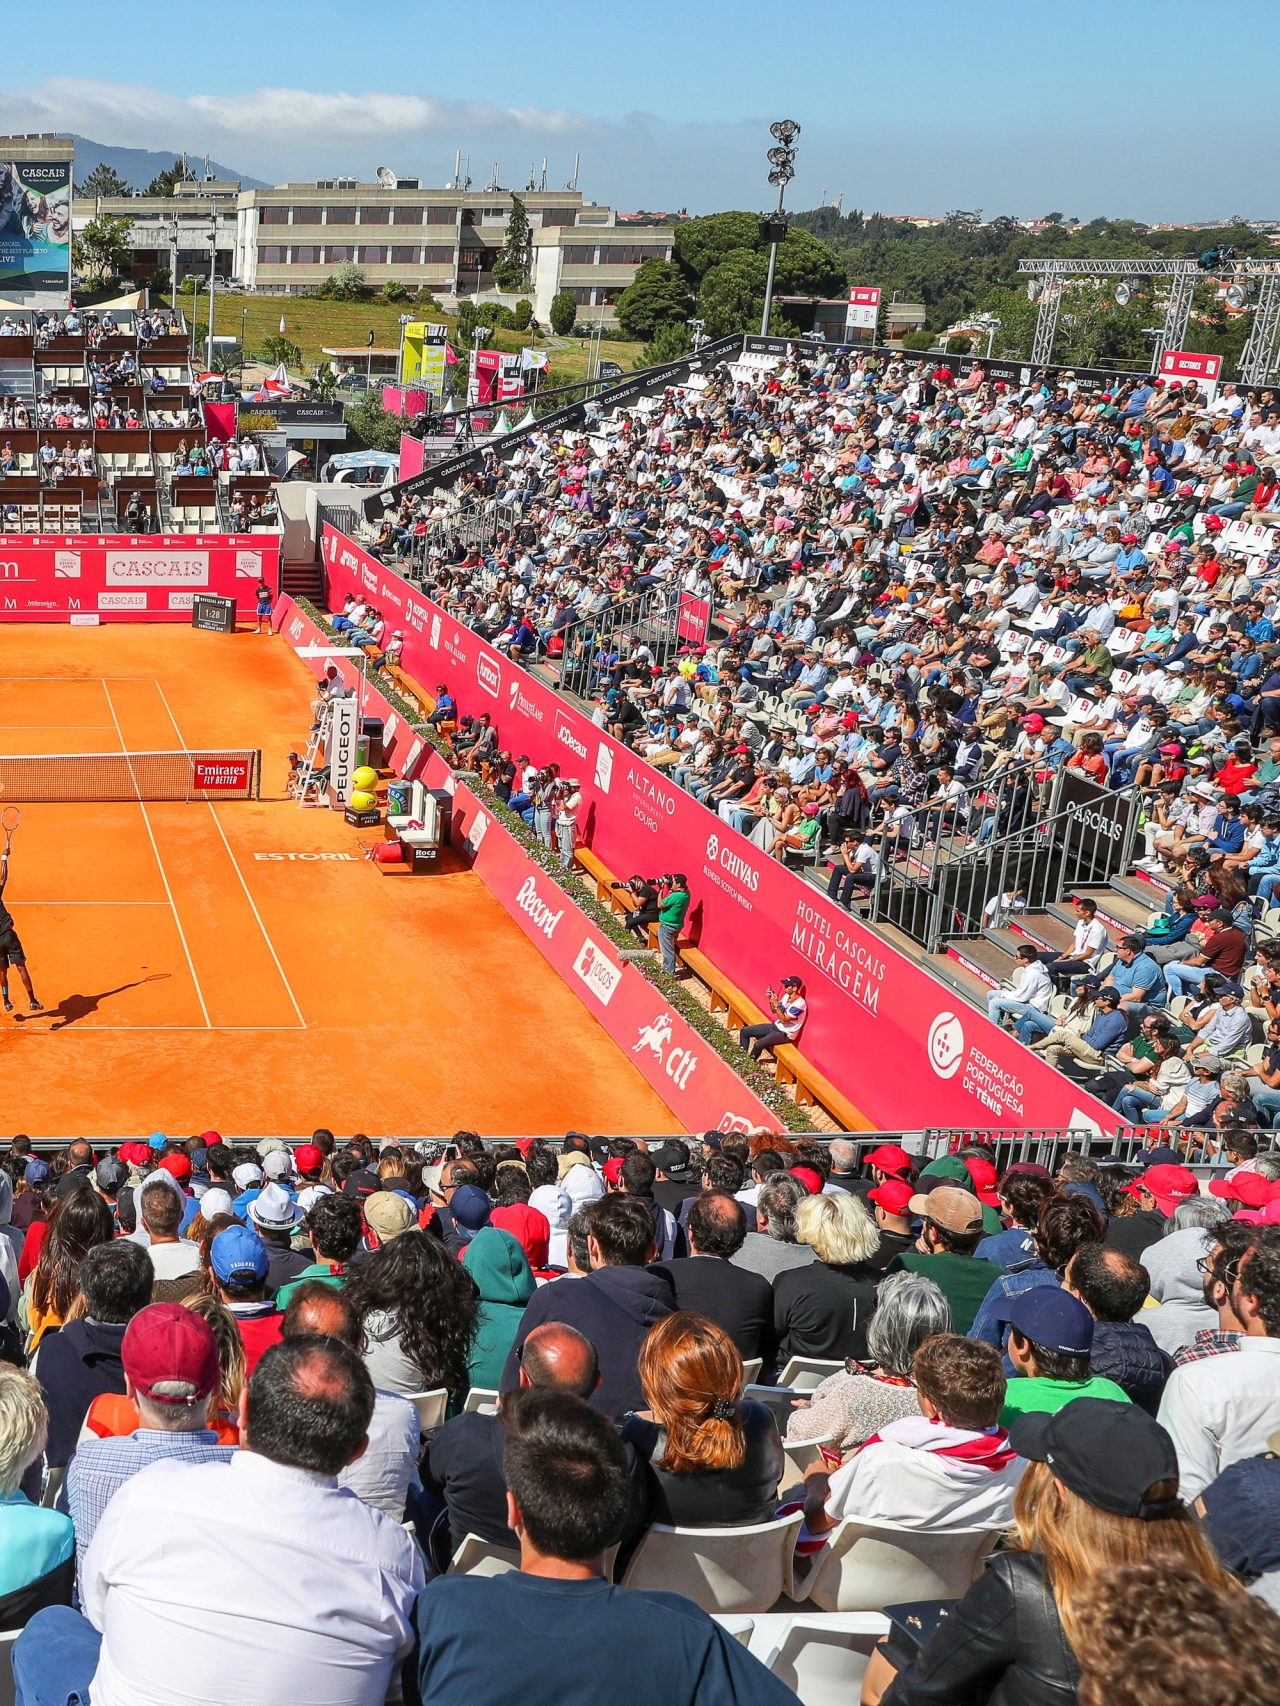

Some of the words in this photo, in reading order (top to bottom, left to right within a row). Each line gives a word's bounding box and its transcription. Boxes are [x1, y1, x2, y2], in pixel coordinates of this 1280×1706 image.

[22, 169, 65, 177] CASCAIS
[647, 370, 672, 386] CASCAIS
[1178, 360, 1201, 370] SECTORES
[604, 389, 630, 405] CASCAIS
[542, 416, 568, 431] CASCAIS
[501, 434, 527, 449] CASCAIS
[441, 462, 466, 477] CASCAIS
[112, 561, 202, 577] CASCAIS
[101, 596, 144, 605] CASCAIS
[479, 663, 497, 687] funbox
[557, 724, 588, 759] JCDecaux
[337, 709, 350, 803] PEUGEOT
[197, 764, 245, 776] Emirates
[204, 776, 214, 784] FLY
[216, 775, 238, 784] BETTER
[626, 768, 675, 815] ALTANO
[634, 806, 657, 833] DOURO
[1066, 801, 1122, 841] CASCAIS
[253, 852, 360, 861] ESTORIL
[720, 848, 760, 892] CHIVAS
[703, 864, 721, 886] BLENDED
[720, 877, 738, 899] SCOTCH
[737, 891, 753, 912] WHISKY
[516, 875, 566, 939] Record
[797, 900, 831, 940] HOTEL
[835, 931, 886, 981] CASCAIS
[591, 960, 615, 990] JOGOS
[791, 922, 880, 1014] MIRAGEM
[980, 971, 990, 982] AQUI
[665, 1046, 699, 1091] ctt
[970, 1046, 1024, 1097] FEDERAÇÃO
[963, 1076, 974, 1095] DE
[976, 1086, 1003, 1117] TÉNIS
[966, 1062, 1024, 1118] PORTUGUESA
